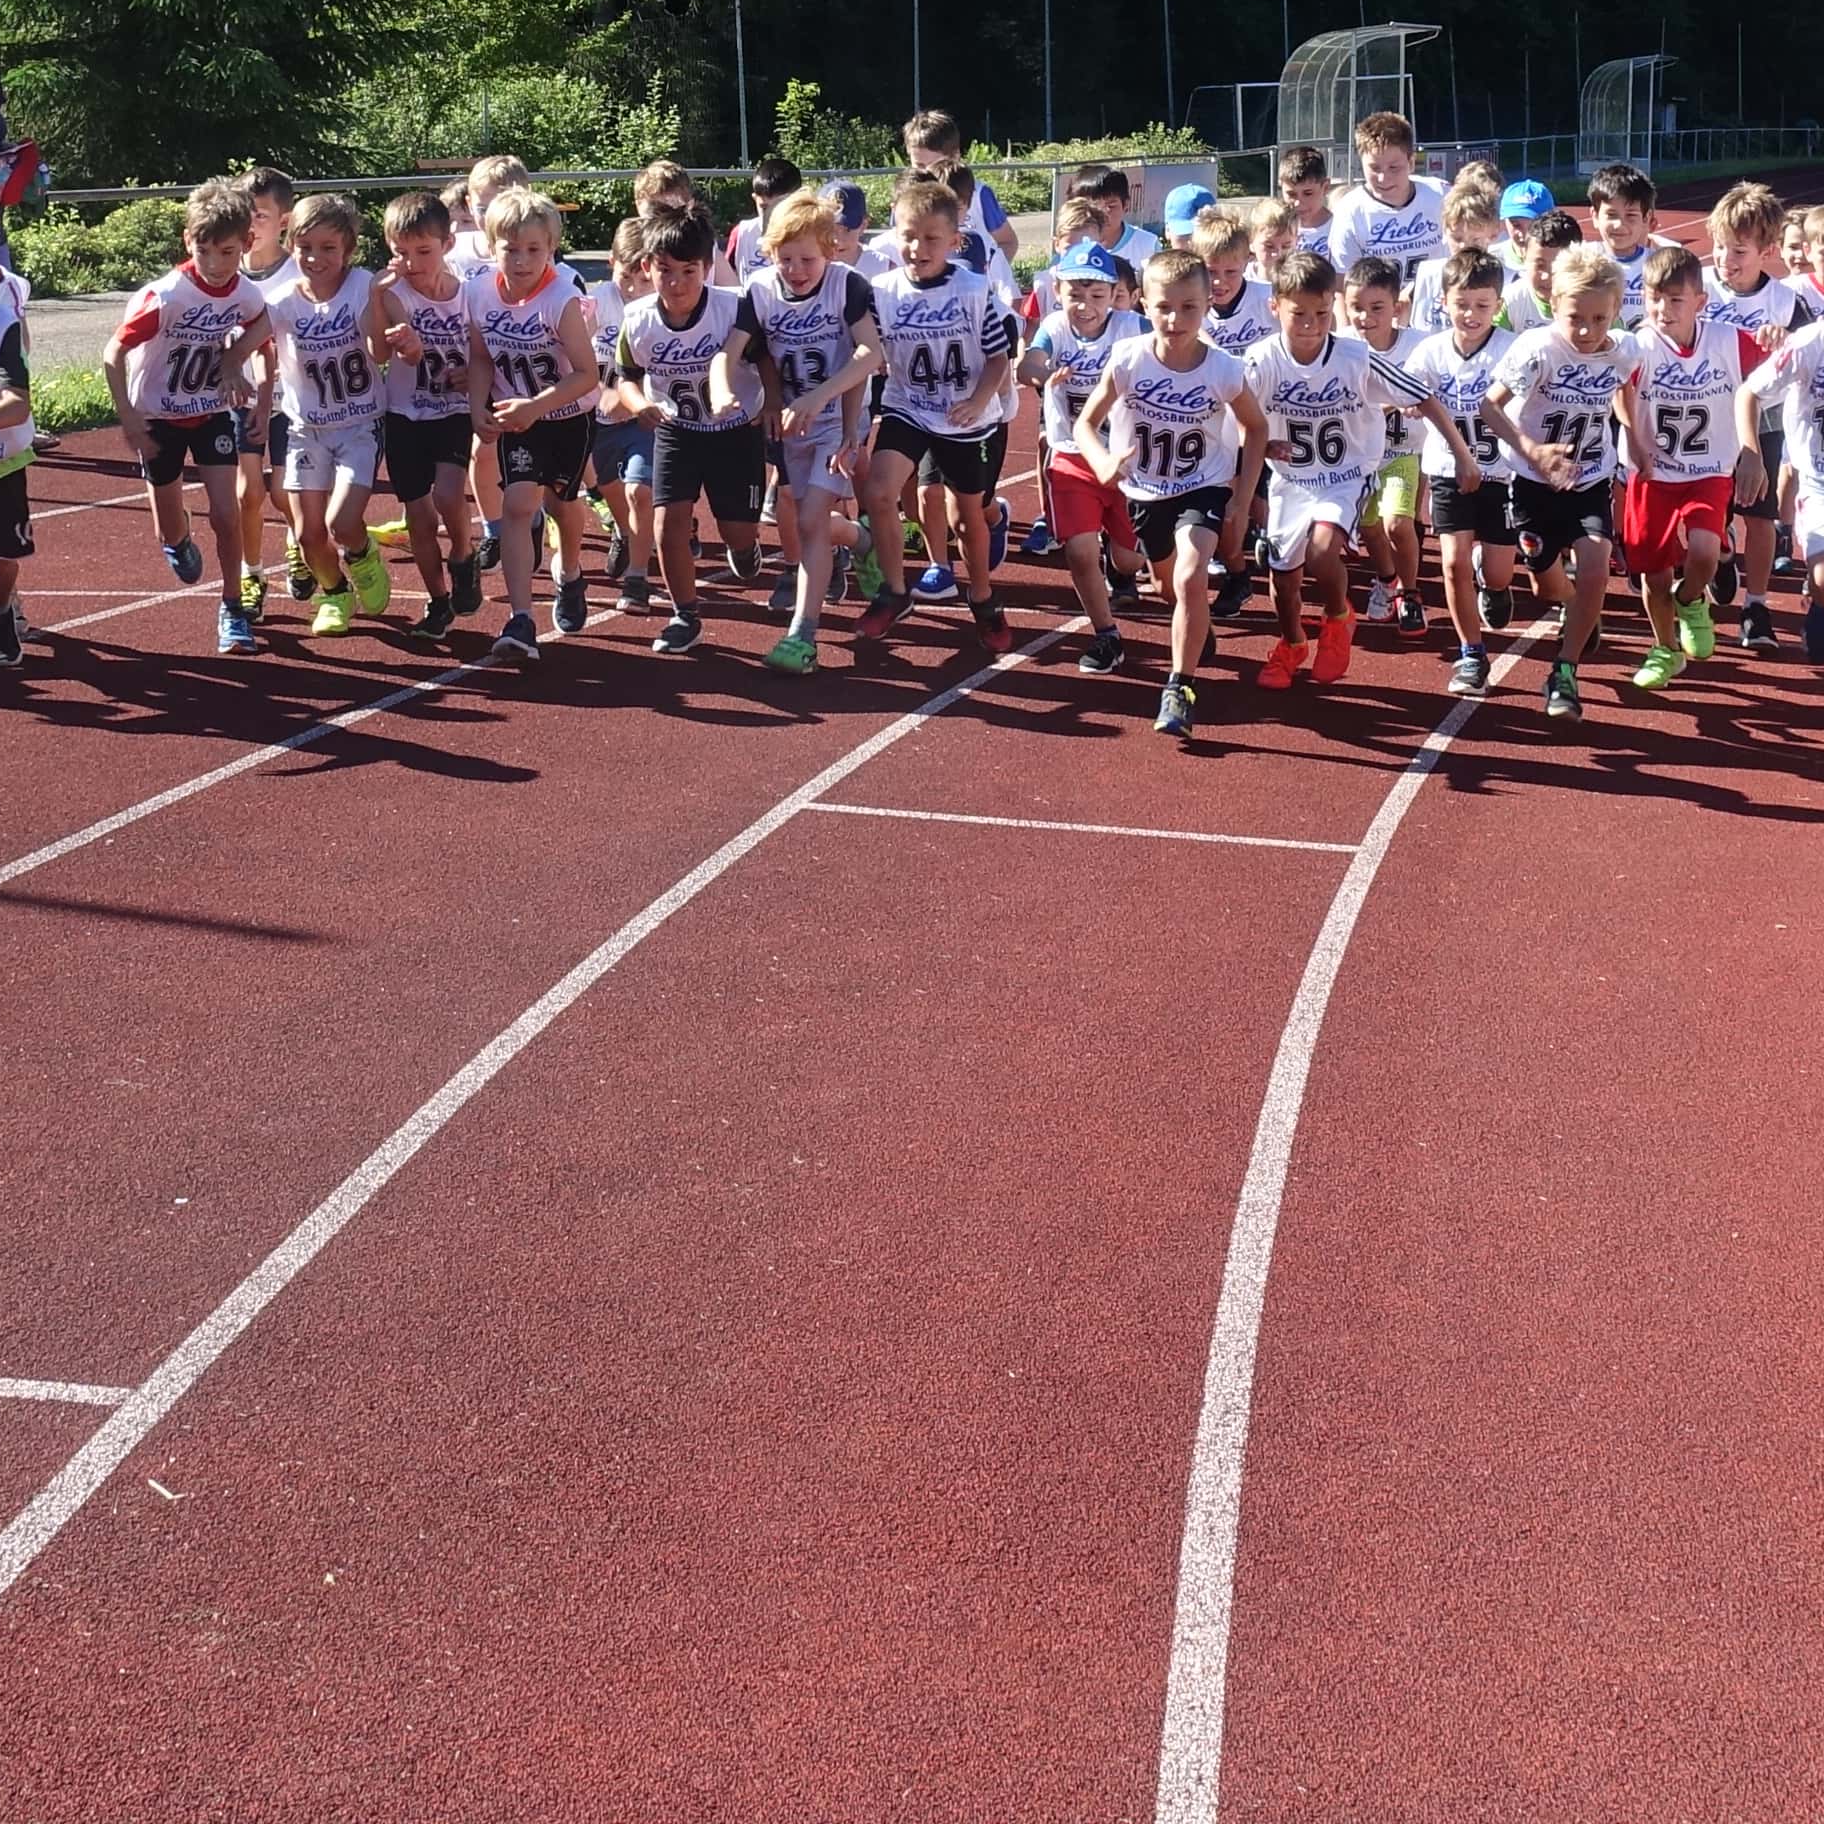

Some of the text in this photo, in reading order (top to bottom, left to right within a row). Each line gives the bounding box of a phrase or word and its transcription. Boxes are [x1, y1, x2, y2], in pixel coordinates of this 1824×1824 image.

[1365, 212, 1439, 246] Lieler
[764, 303, 840, 336] Lieler
[303, 348, 373, 409] 118
[908, 339, 971, 396] 44
[1652, 359, 1726, 392] Lieler
[1125, 378, 1220, 415] Lieler
[1272, 376, 1358, 410] Lieler
[1134, 421, 1207, 480] 119
[1286, 417, 1348, 468] 56
[1655, 404, 1710, 458] 52
